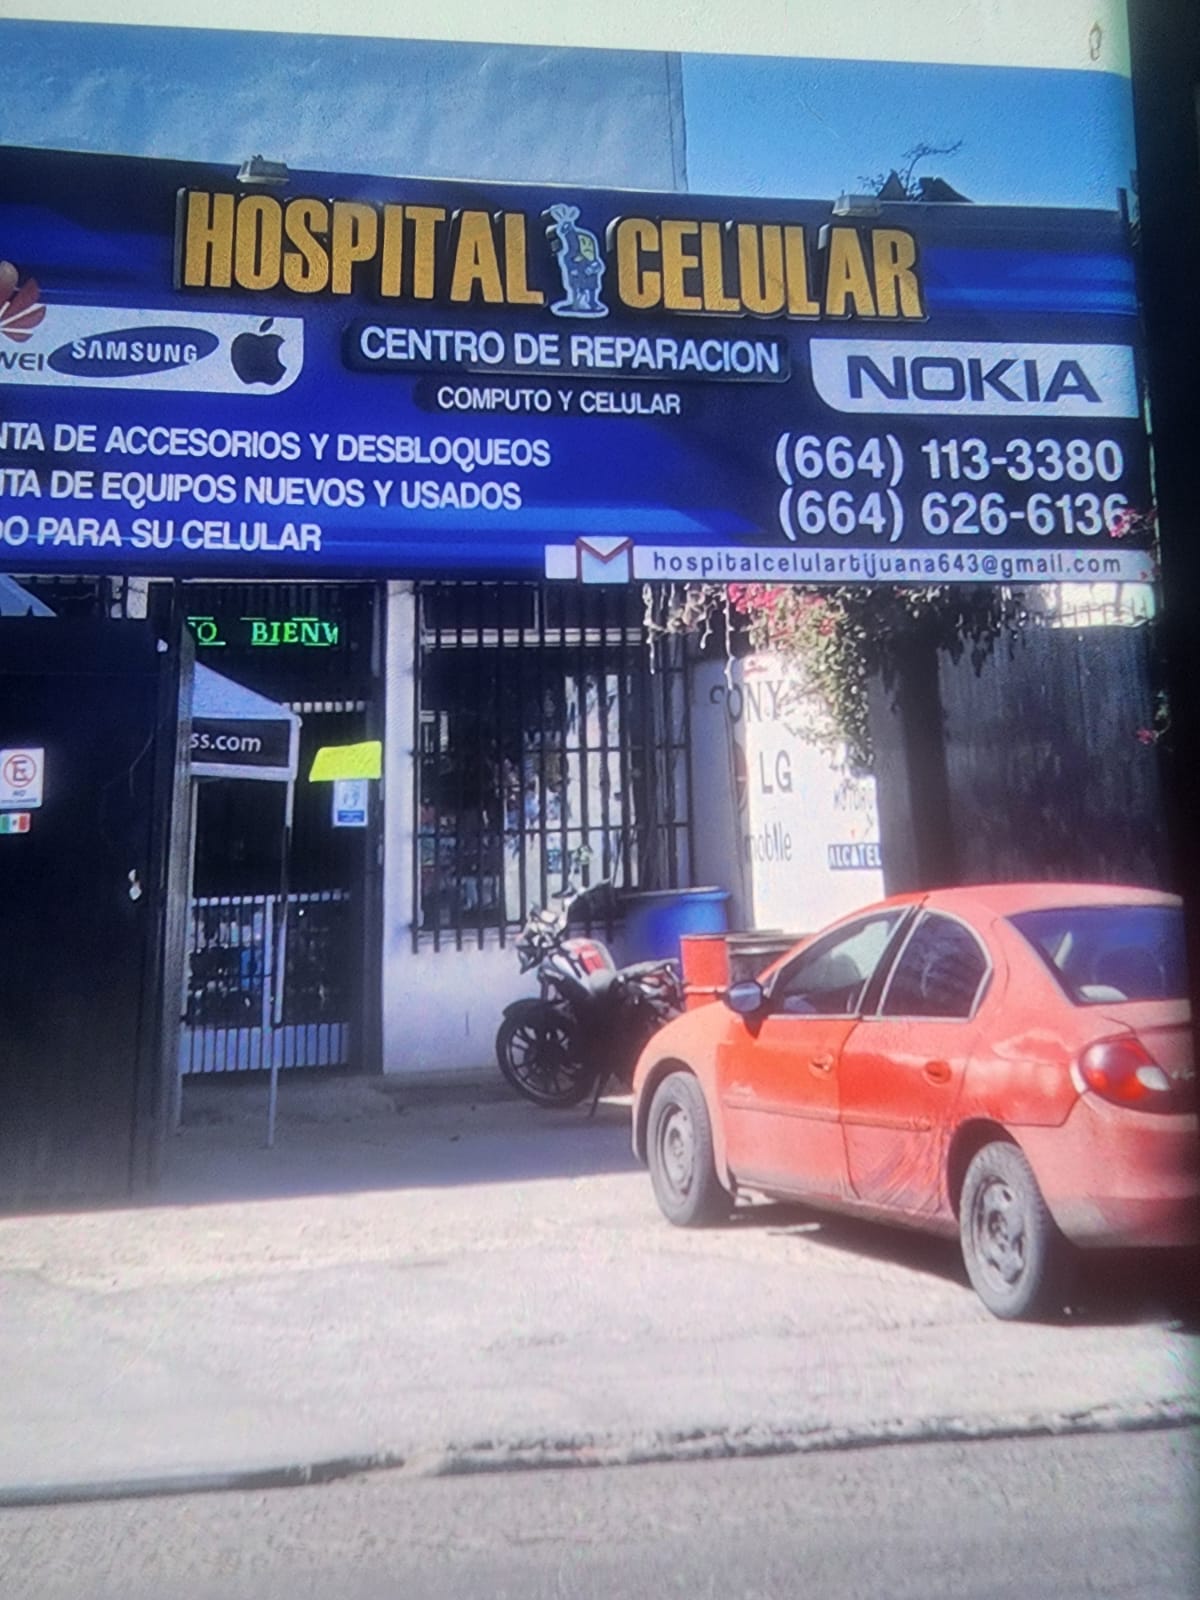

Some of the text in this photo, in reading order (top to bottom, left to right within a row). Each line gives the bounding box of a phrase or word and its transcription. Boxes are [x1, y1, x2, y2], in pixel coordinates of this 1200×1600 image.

[184, 191, 924, 318] HOSPITAL CELULAR
[71, 339, 198, 363] SAMSUNG
[360, 326, 778, 374] CENTRO DE REPARACION
[437, 386, 681, 415] COMPUTO Y CELULAR
[847, 355, 1102, 403] NOKIA
[54, 424, 97, 452] DE
[104, 426, 301, 461] ACCESORIOS
[309, 433, 329, 460] Y
[337, 435, 551, 473] DESBLOQUEOS
[775, 432, 1124, 486] (664) 113-3380
[0, 468, 522, 511] TA DE EQUIPOS NUEVOS Y USADOS
[0, 515, 322, 551] O PARA SU CELULAR
[779, 486, 1131, 542] (664) 626-6136
[653, 551, 1121, 578] hospitalcelulartijuana643@gmail.com
[759, 749, 793, 794] LG
[828, 844, 882, 867] ALCATEL
